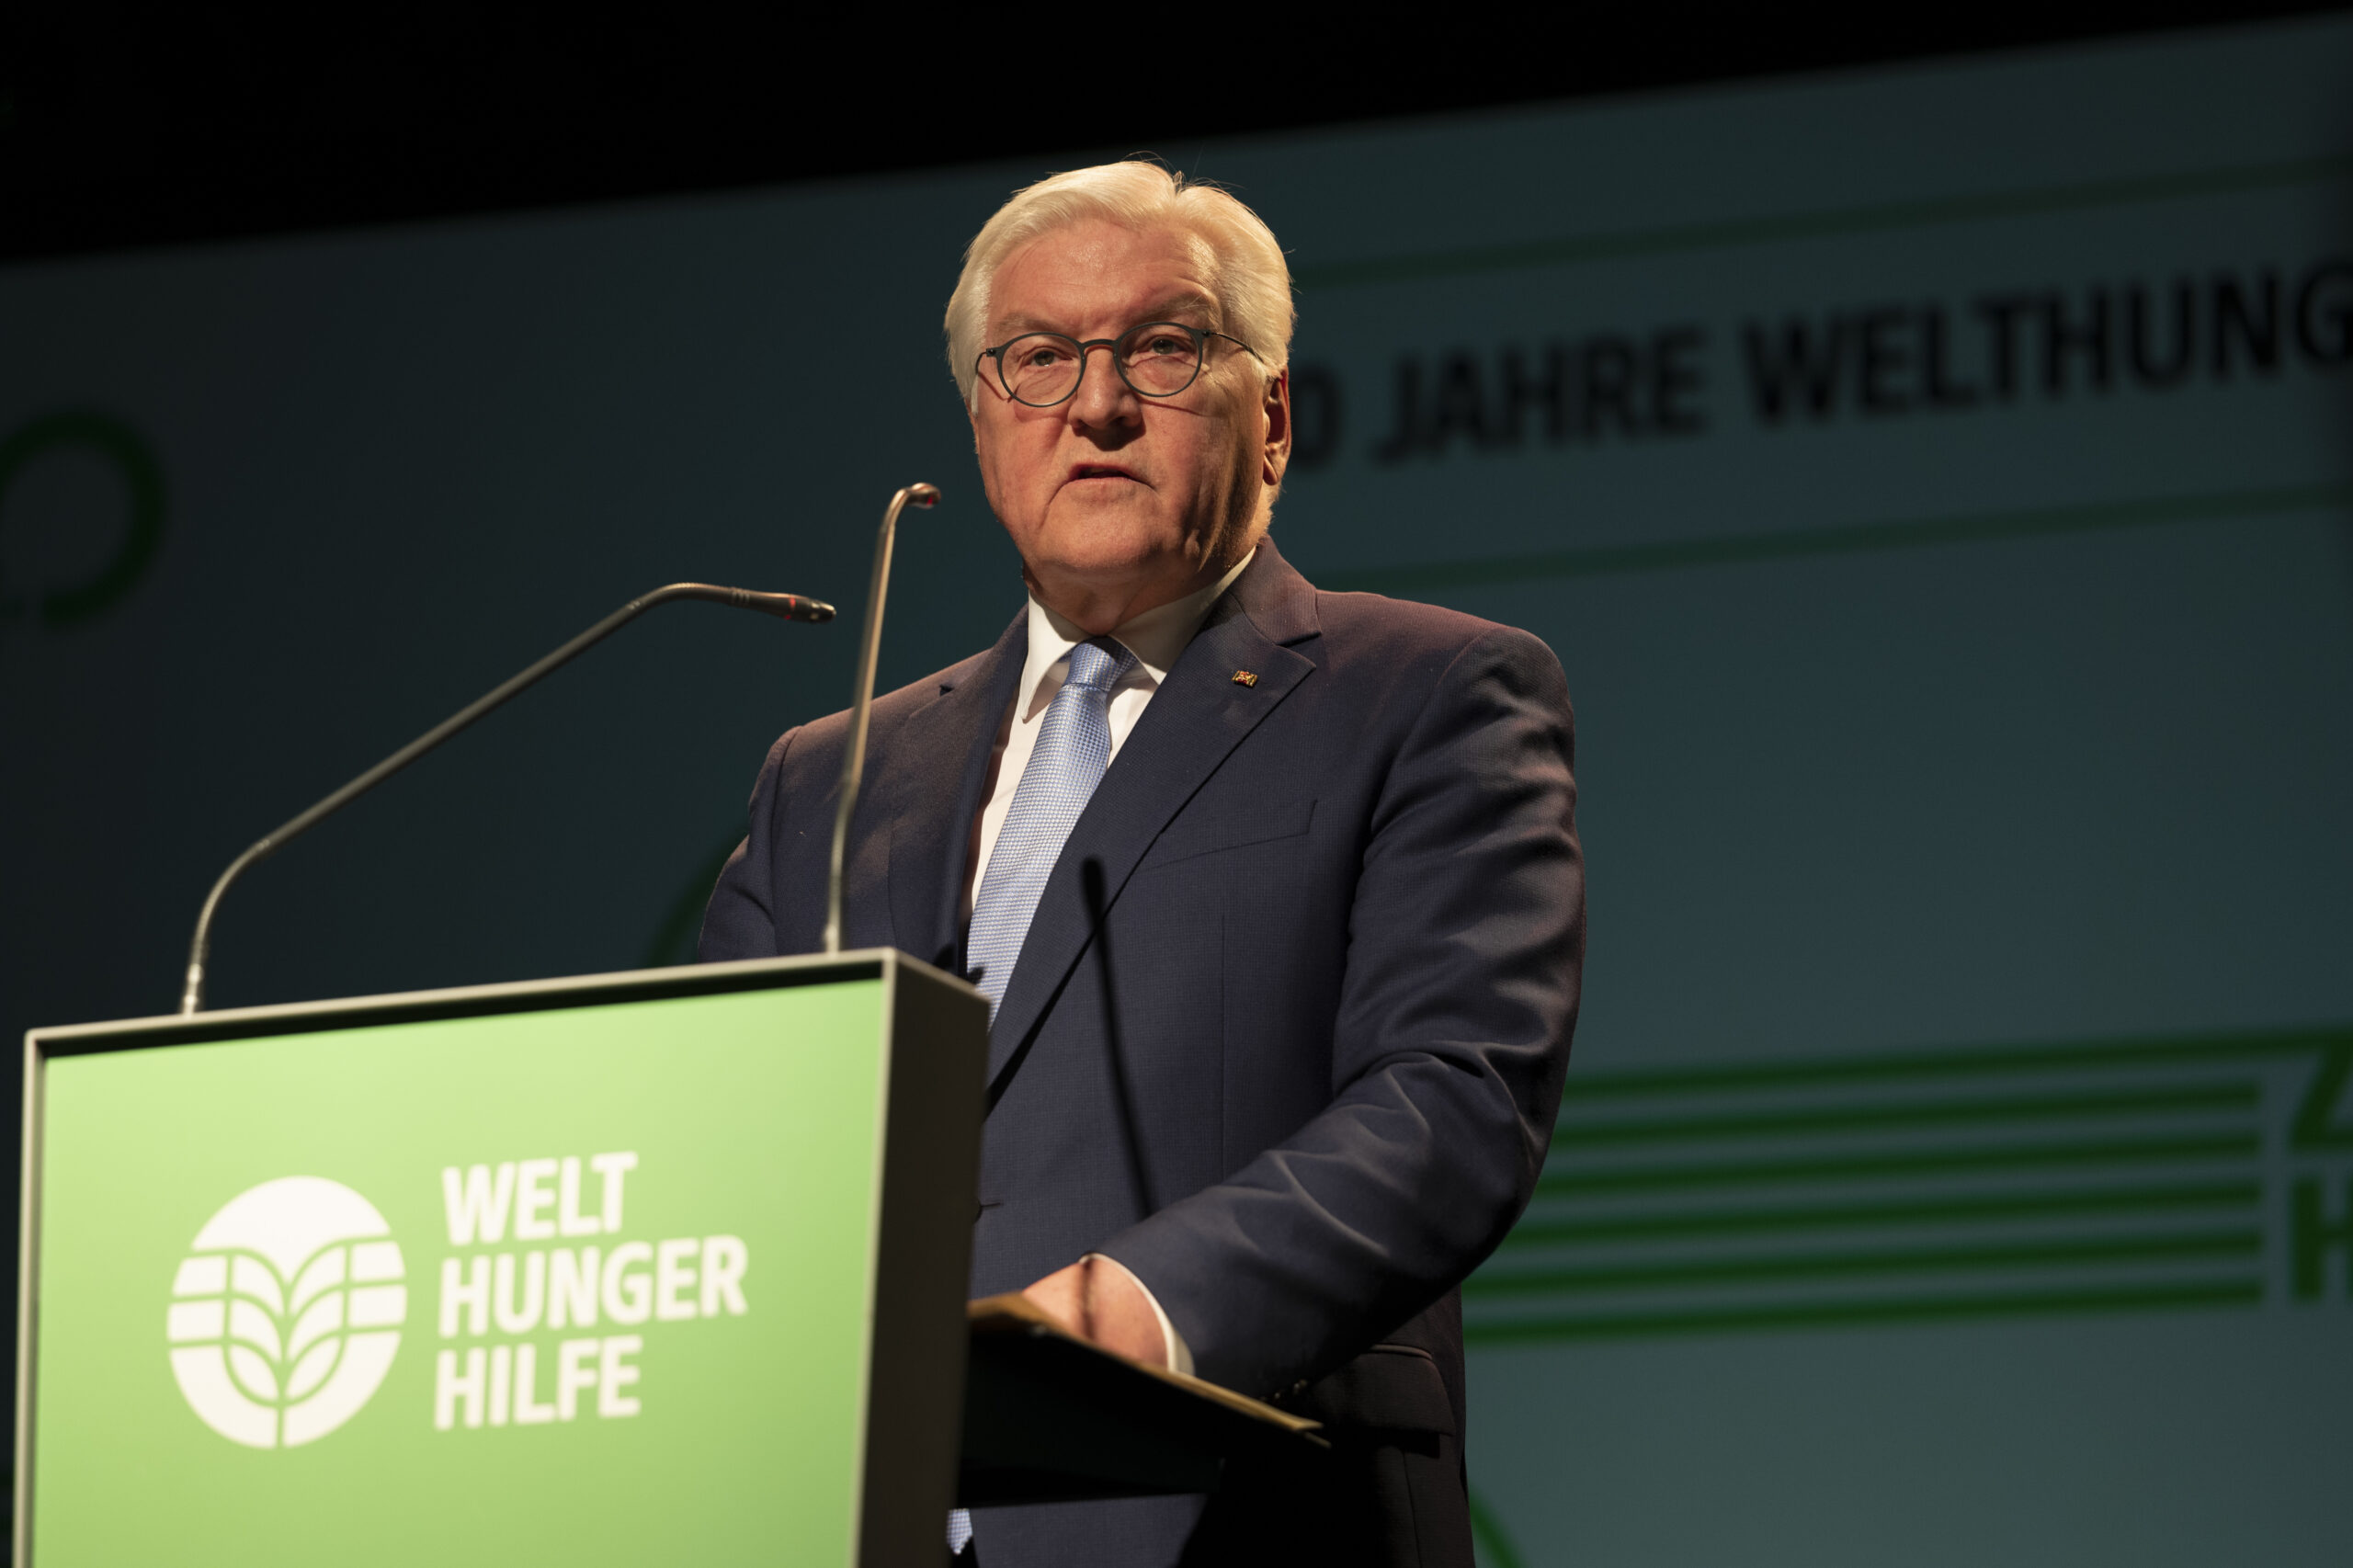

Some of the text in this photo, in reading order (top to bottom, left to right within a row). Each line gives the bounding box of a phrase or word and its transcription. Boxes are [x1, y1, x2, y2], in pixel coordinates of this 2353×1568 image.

[1370, 325, 1708, 464] JAHRE
[1744, 257, 2353, 424] WELTHUNG
[442, 1152, 638, 1246] WELT
[438, 1235, 749, 1338] HUNGER
[434, 1335, 642, 1431] HILFE
